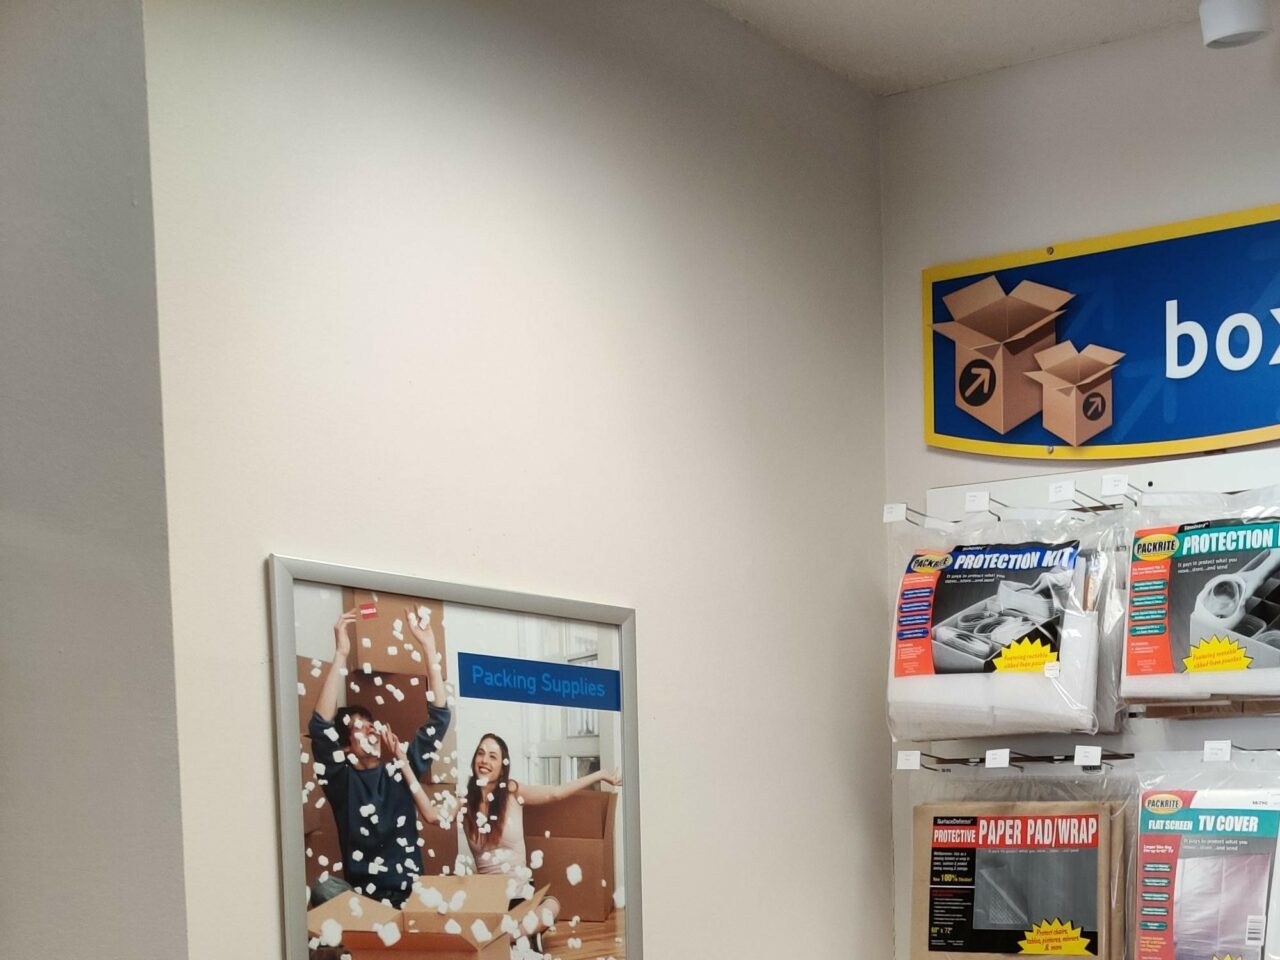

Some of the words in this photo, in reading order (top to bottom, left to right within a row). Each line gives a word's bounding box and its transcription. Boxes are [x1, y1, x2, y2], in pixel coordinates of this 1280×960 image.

[1137, 540, 1176, 554] PACKRITE
[1182, 528, 1273, 556] PROTECTION
[954, 551, 1040, 570] PROTECTION
[1042, 547, 1074, 567] KIT
[471, 666, 537, 692] Packing
[540, 673, 606, 698] Supplies
[1147, 799, 1180, 808] PACKRITE
[979, 818, 1022, 845] PAPER
[1027, 817, 1098, 847] PAD/WRAP
[1148, 819, 1165, 830] FLAT
[1165, 820, 1193, 831] SCREEN
[1199, 815, 1215, 831] TV
[1216, 815, 1259, 832] COVER
[933, 829, 976, 843] PROTECTIVE
